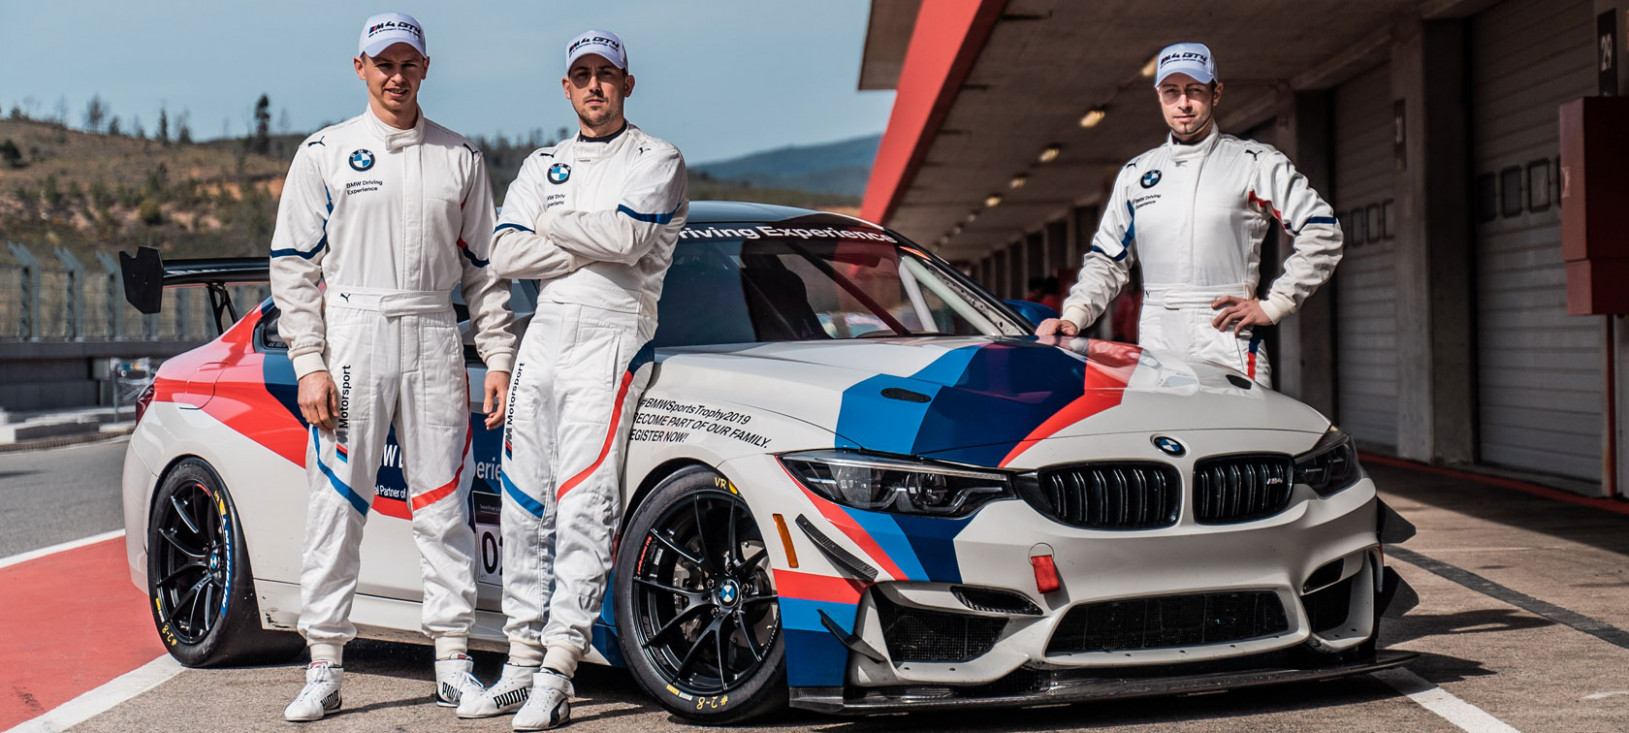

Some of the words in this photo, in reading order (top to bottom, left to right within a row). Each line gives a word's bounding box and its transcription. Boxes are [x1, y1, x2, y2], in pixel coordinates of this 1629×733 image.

[1600, 33, 1612, 71] 29
[346, 187, 378, 195] Experience
[678, 225, 760, 240] riving
[756, 225, 898, 244] Experience
[338, 365, 352, 429] Motorsport
[507, 362, 525, 426] Motorsport
[629, 429, 665, 442] EGISTER
[664, 431, 690, 443] NOW!
[668, 416, 695, 428] PART
[694, 420, 710, 431] OF
[707, 423, 731, 436] OUR
[730, 428, 772, 449] FAMILY.
[379, 484, 400, 497] Partner
[400, 487, 407, 499] of
[714, 477, 727, 490] VR
[482, 530, 503, 577] 0
[493, 686, 529, 709] PUMA
